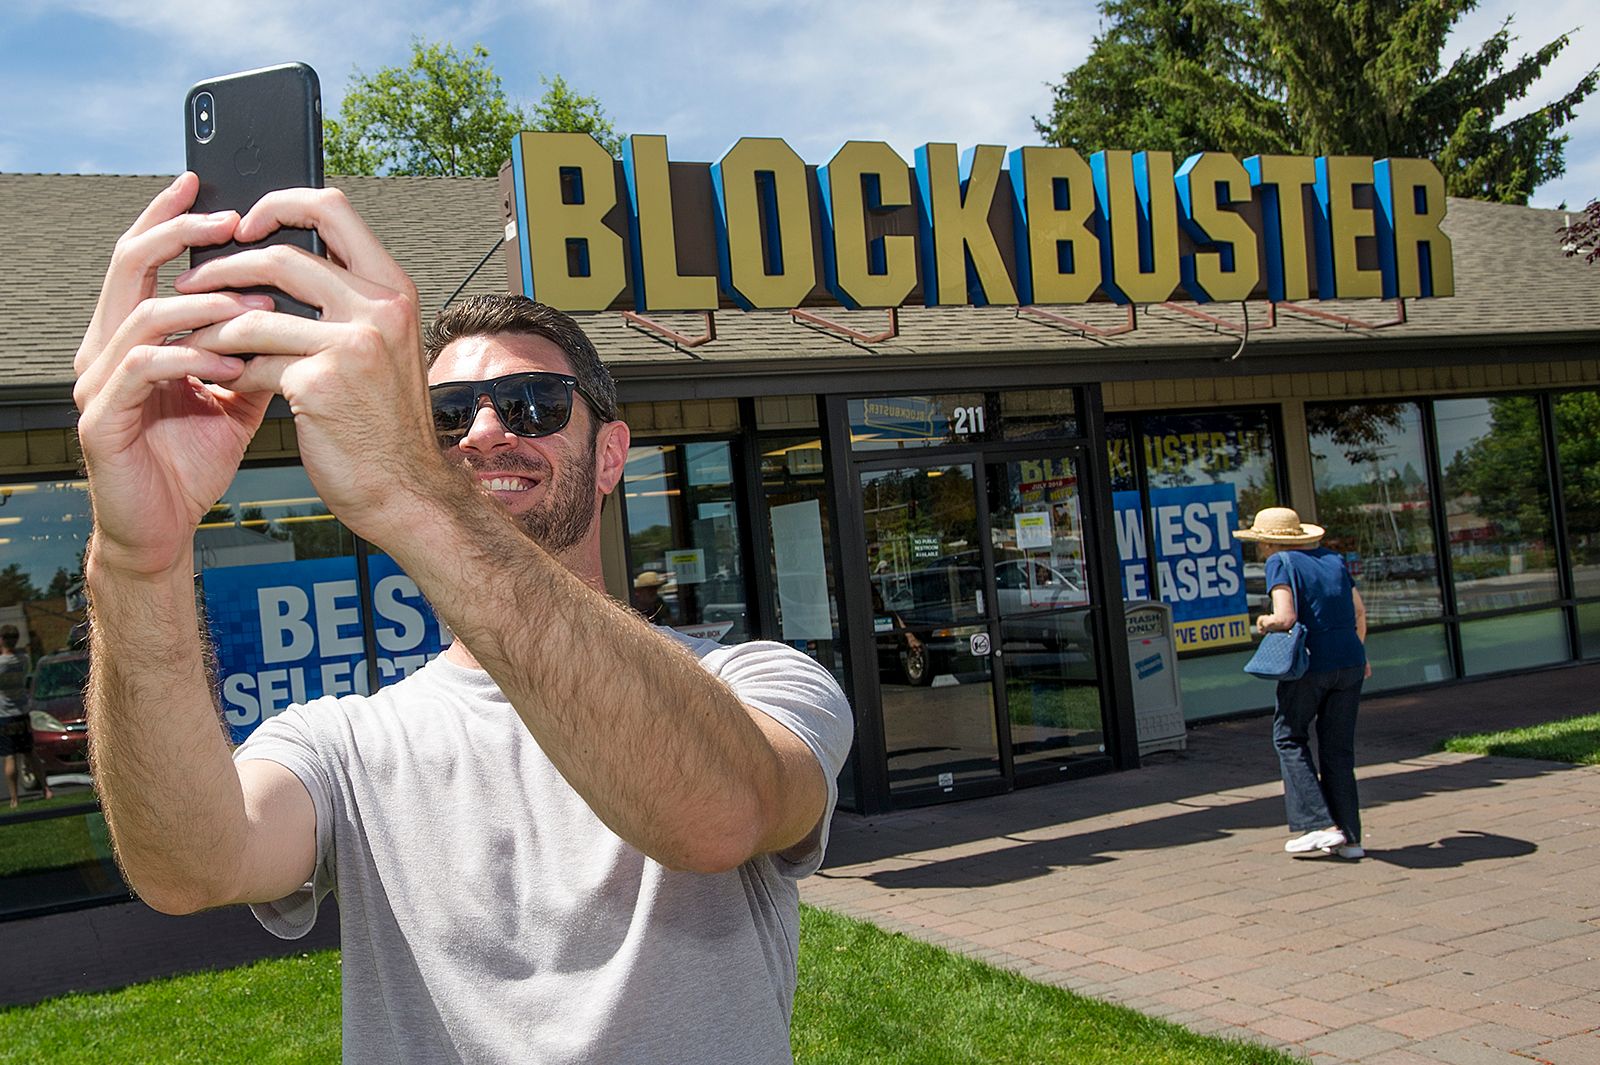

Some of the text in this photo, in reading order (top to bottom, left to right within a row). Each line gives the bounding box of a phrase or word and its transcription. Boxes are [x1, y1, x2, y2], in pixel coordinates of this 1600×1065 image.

[512, 131, 1454, 312] BLOCKBUSTER
[954, 406, 985, 434] 211
[1032, 482, 1047, 490] JULY
[1123, 554, 1240, 602] EASES
[257, 574, 452, 664] BES
[1128, 624, 1157, 634] ONLY
[1201, 622, 1225, 641] GOT
[1230, 620, 1245, 638] IT!
[707, 630, 721, 638] BOX
